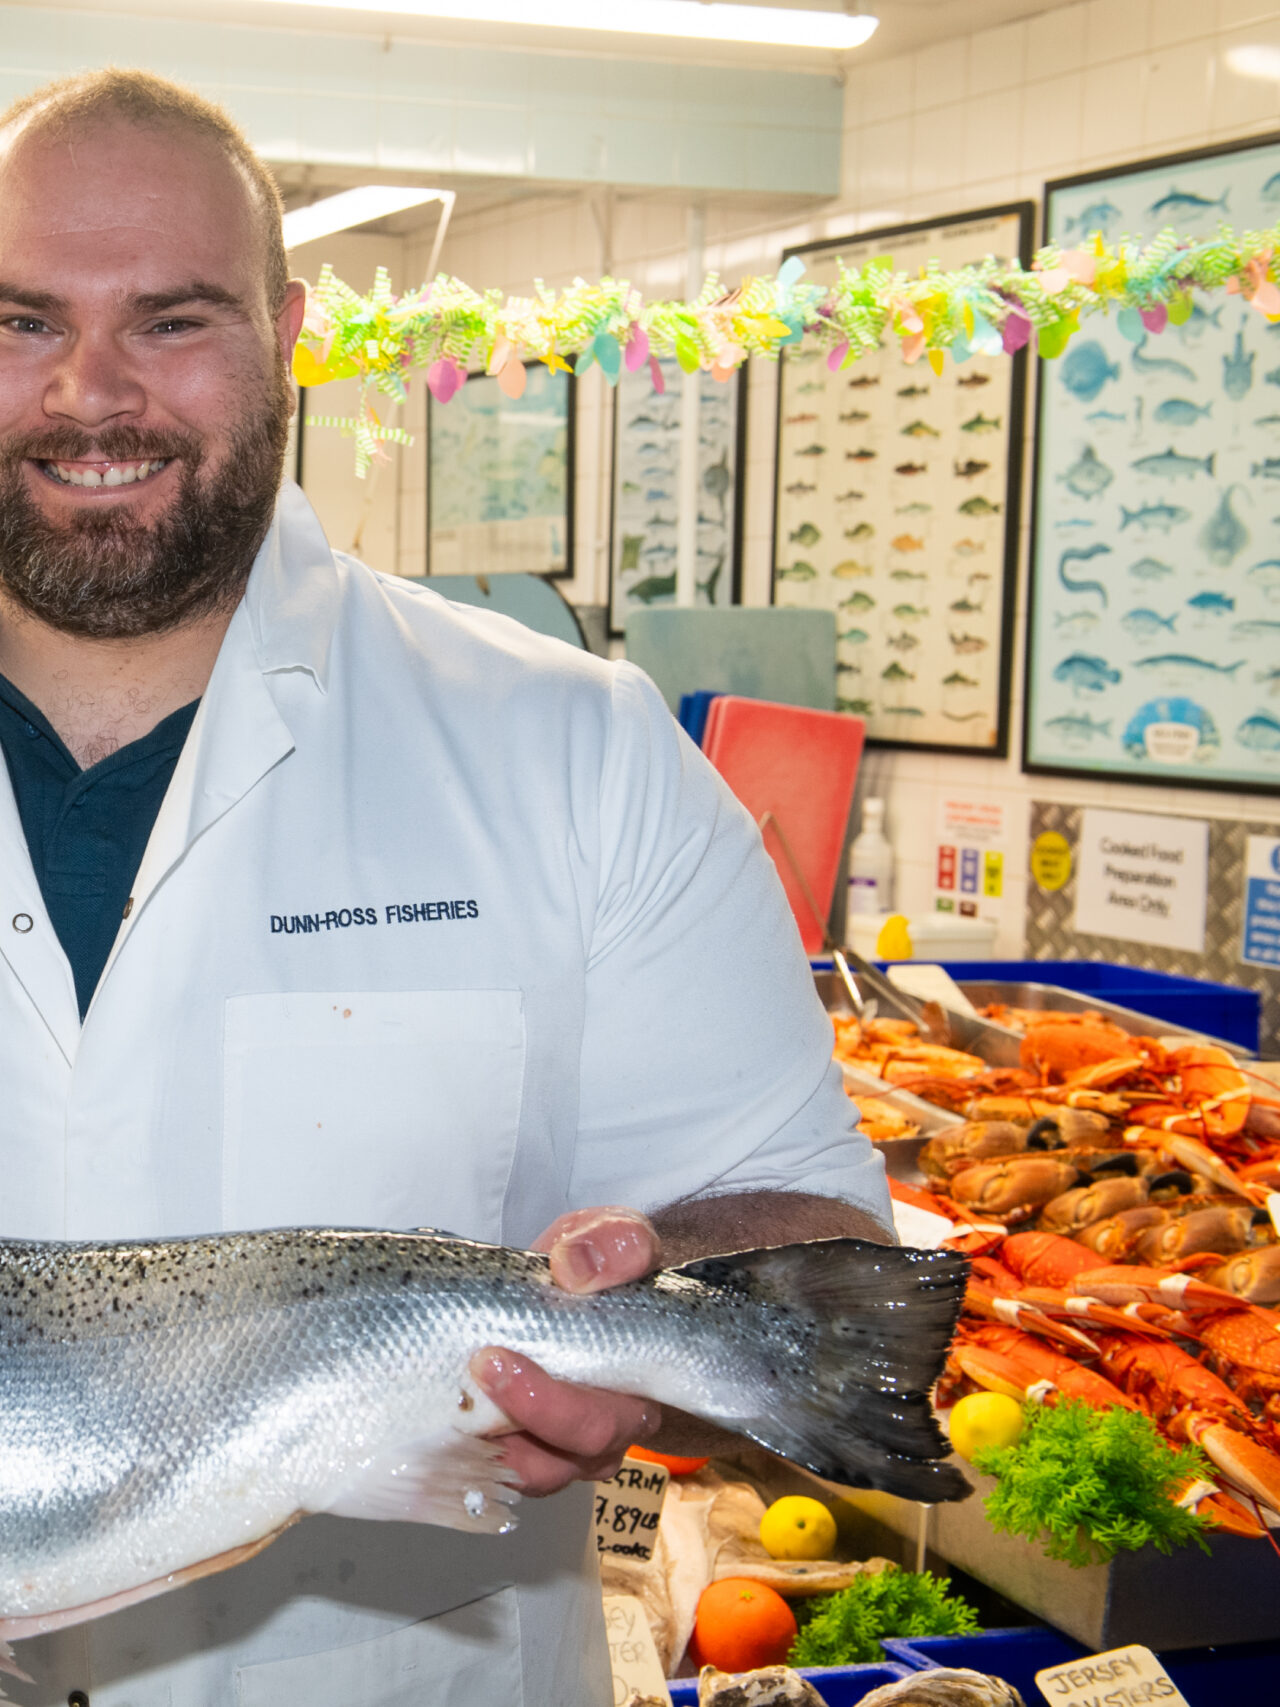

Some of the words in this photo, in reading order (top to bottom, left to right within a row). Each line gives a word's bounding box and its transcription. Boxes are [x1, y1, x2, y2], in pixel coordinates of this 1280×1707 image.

[270, 908, 377, 933] DUNN-ROSS
[386, 900, 479, 924] FISHERIES
[602, 1468, 665, 1494] GRIM
[1047, 1654, 1142, 1695] JERSEY
[1067, 1677, 1176, 1707] YSTERS
